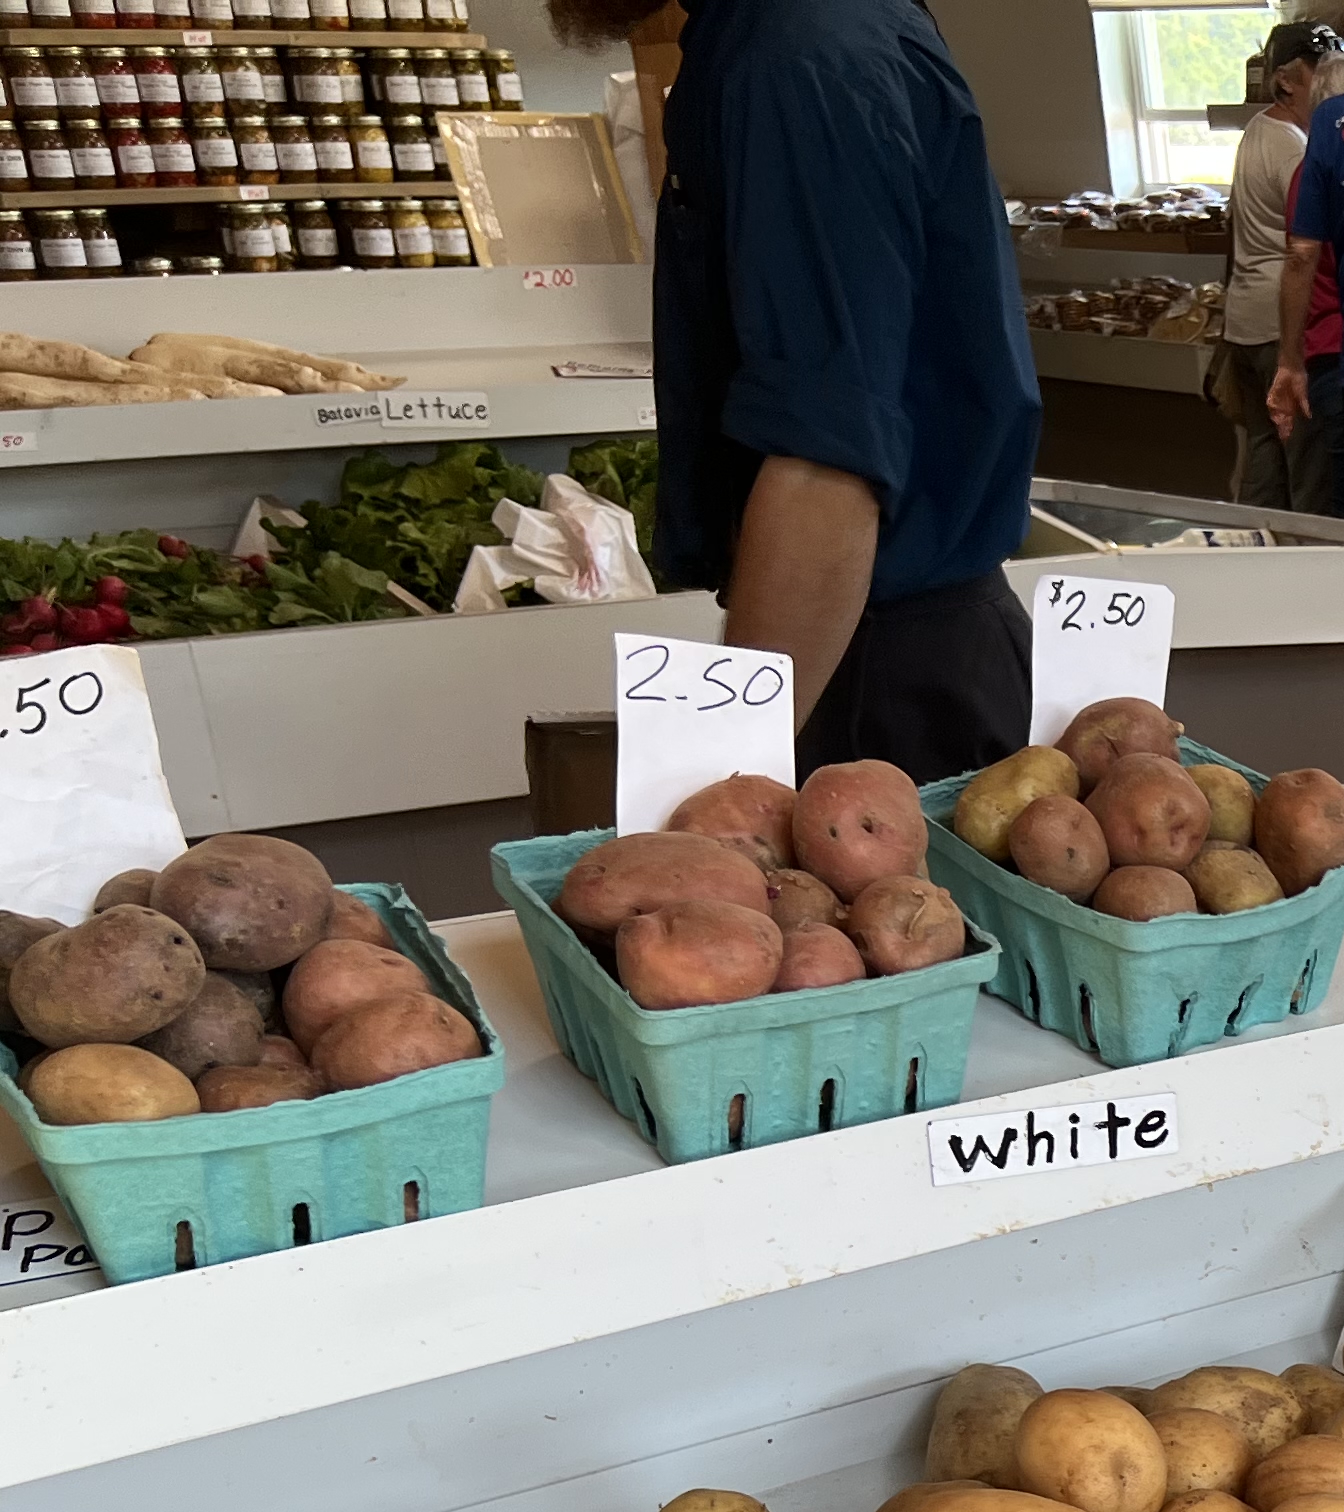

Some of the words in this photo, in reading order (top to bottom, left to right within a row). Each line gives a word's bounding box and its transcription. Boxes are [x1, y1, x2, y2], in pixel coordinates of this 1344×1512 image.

[317, 404, 381, 424] Batavia
[385, 396, 488, 421] Lettuce
[1048, 579, 1146, 631] $2.50
[947, 1101, 1170, 1174] white
